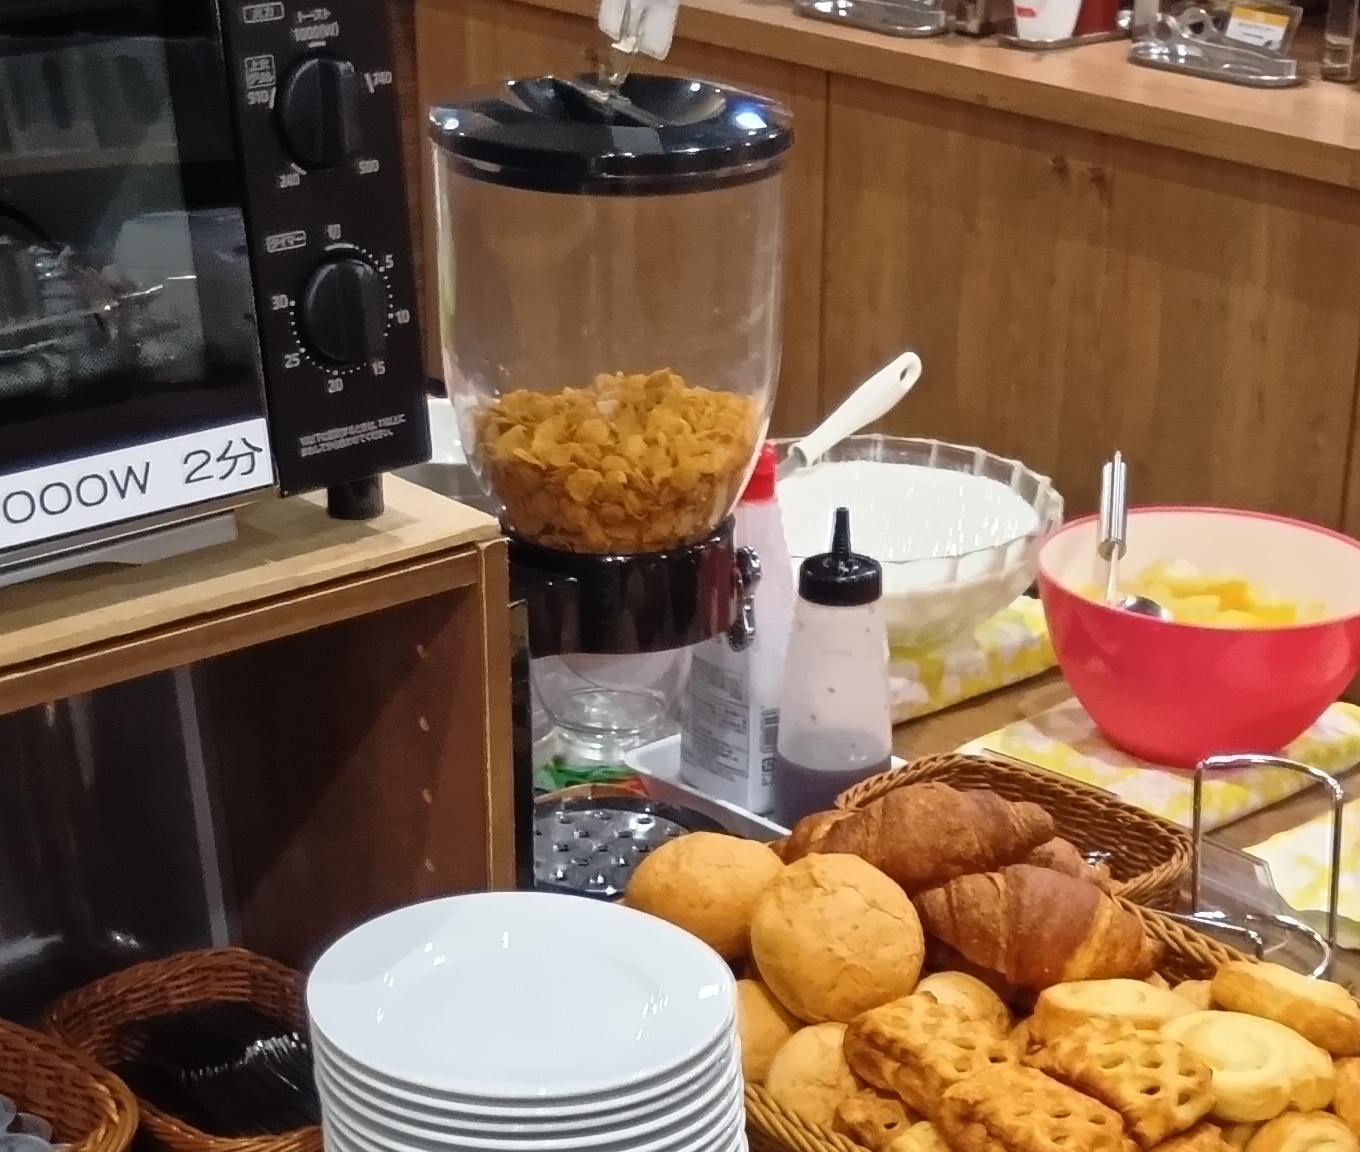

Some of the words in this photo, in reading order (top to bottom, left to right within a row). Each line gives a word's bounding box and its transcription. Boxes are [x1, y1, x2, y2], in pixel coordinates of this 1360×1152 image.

[385, 254, 394, 268] 5
[271, 294, 288, 310] 30
[396, 309, 410, 324] 10
[284, 353, 301, 368] 25
[372, 360, 386, 375] 15
[327, 378, 343, 393] 20
[181, 437, 264, 485] 2分
